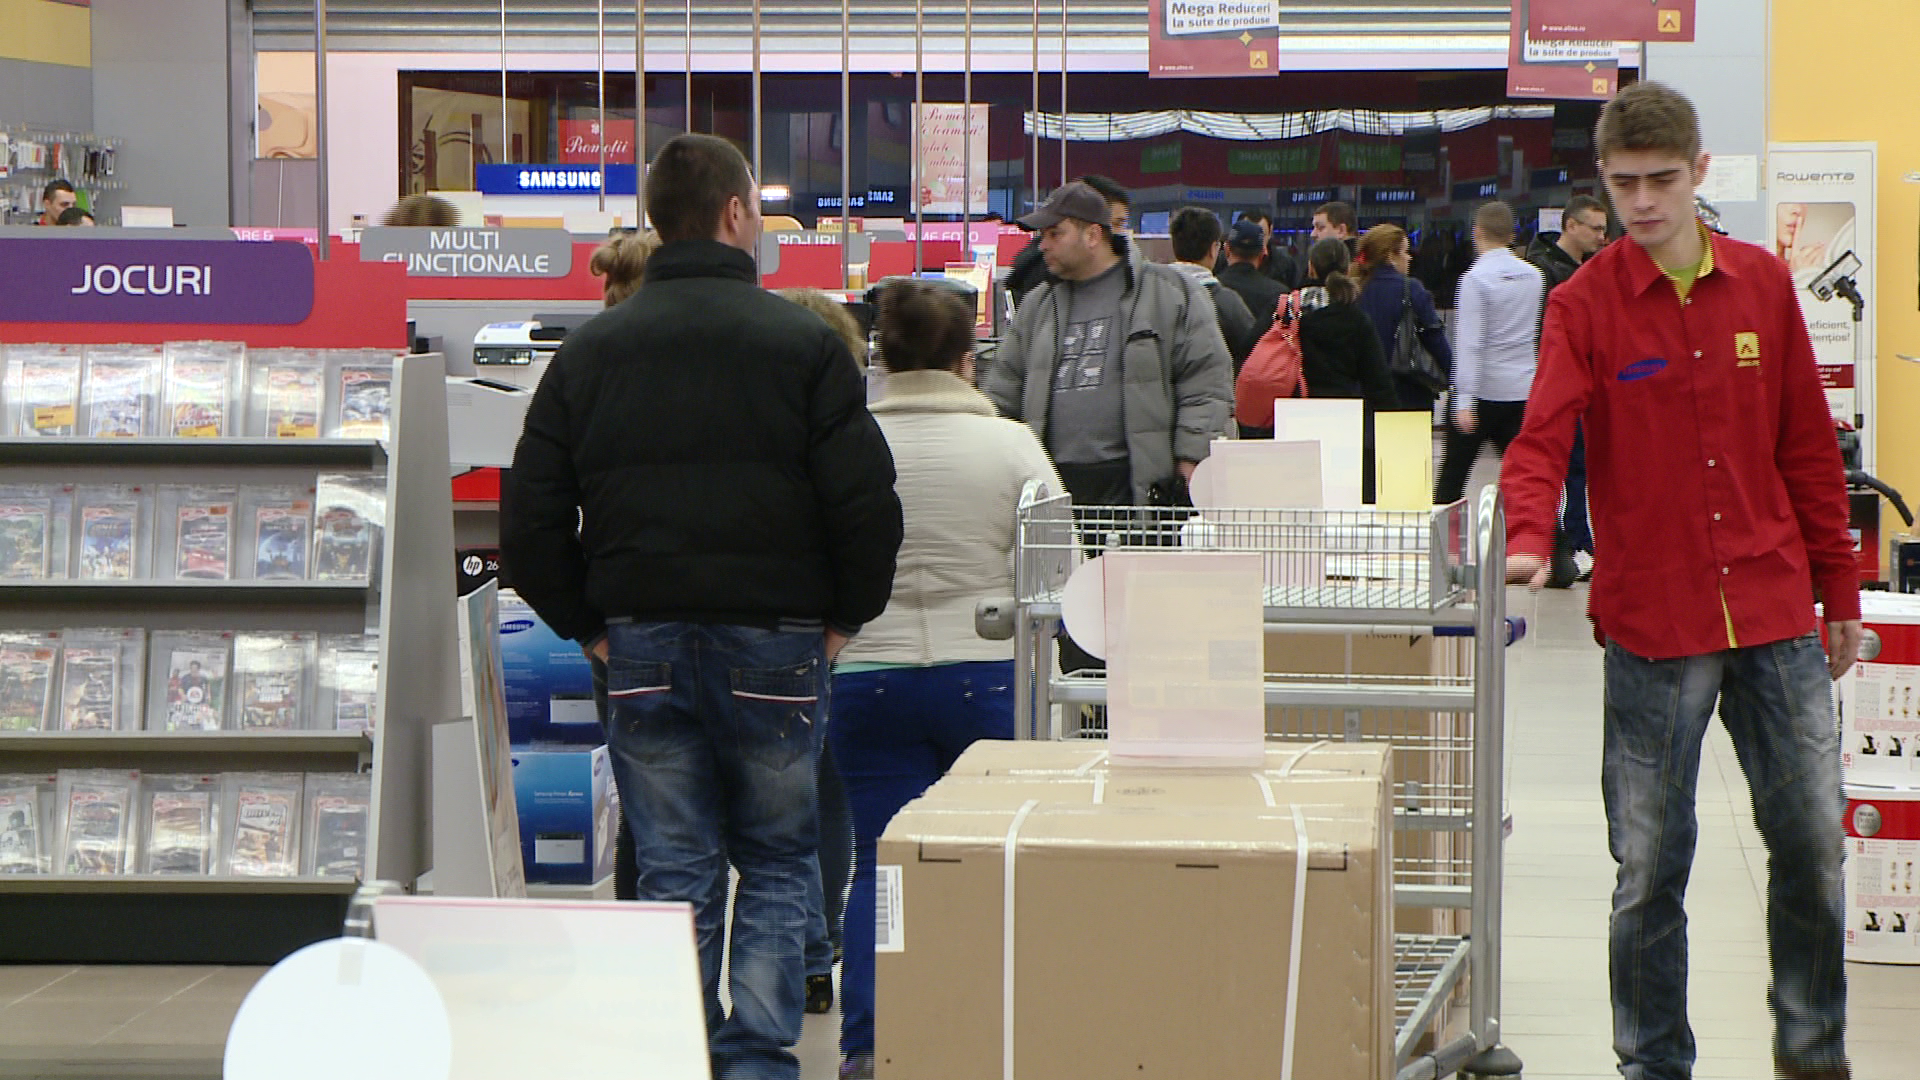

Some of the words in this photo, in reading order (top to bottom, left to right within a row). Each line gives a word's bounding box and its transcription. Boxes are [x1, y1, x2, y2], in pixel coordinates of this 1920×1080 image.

[1172, 3, 1214, 16] Mega
[1218, 3, 1271, 14] Reduceri
[1172, 18, 1184, 28] la
[1188, 18, 1214, 28] sute
[1217, 17, 1230, 26] de
[1233, 16, 1270, 27] produse
[1542, 48, 1565, 56] sute
[1566, 48, 1579, 56] de
[519, 171, 601, 188] SAMSUNG
[430, 231, 500, 250] MULTI
[71, 265, 211, 294] JOCURI
[464, 555, 483, 577] hp
